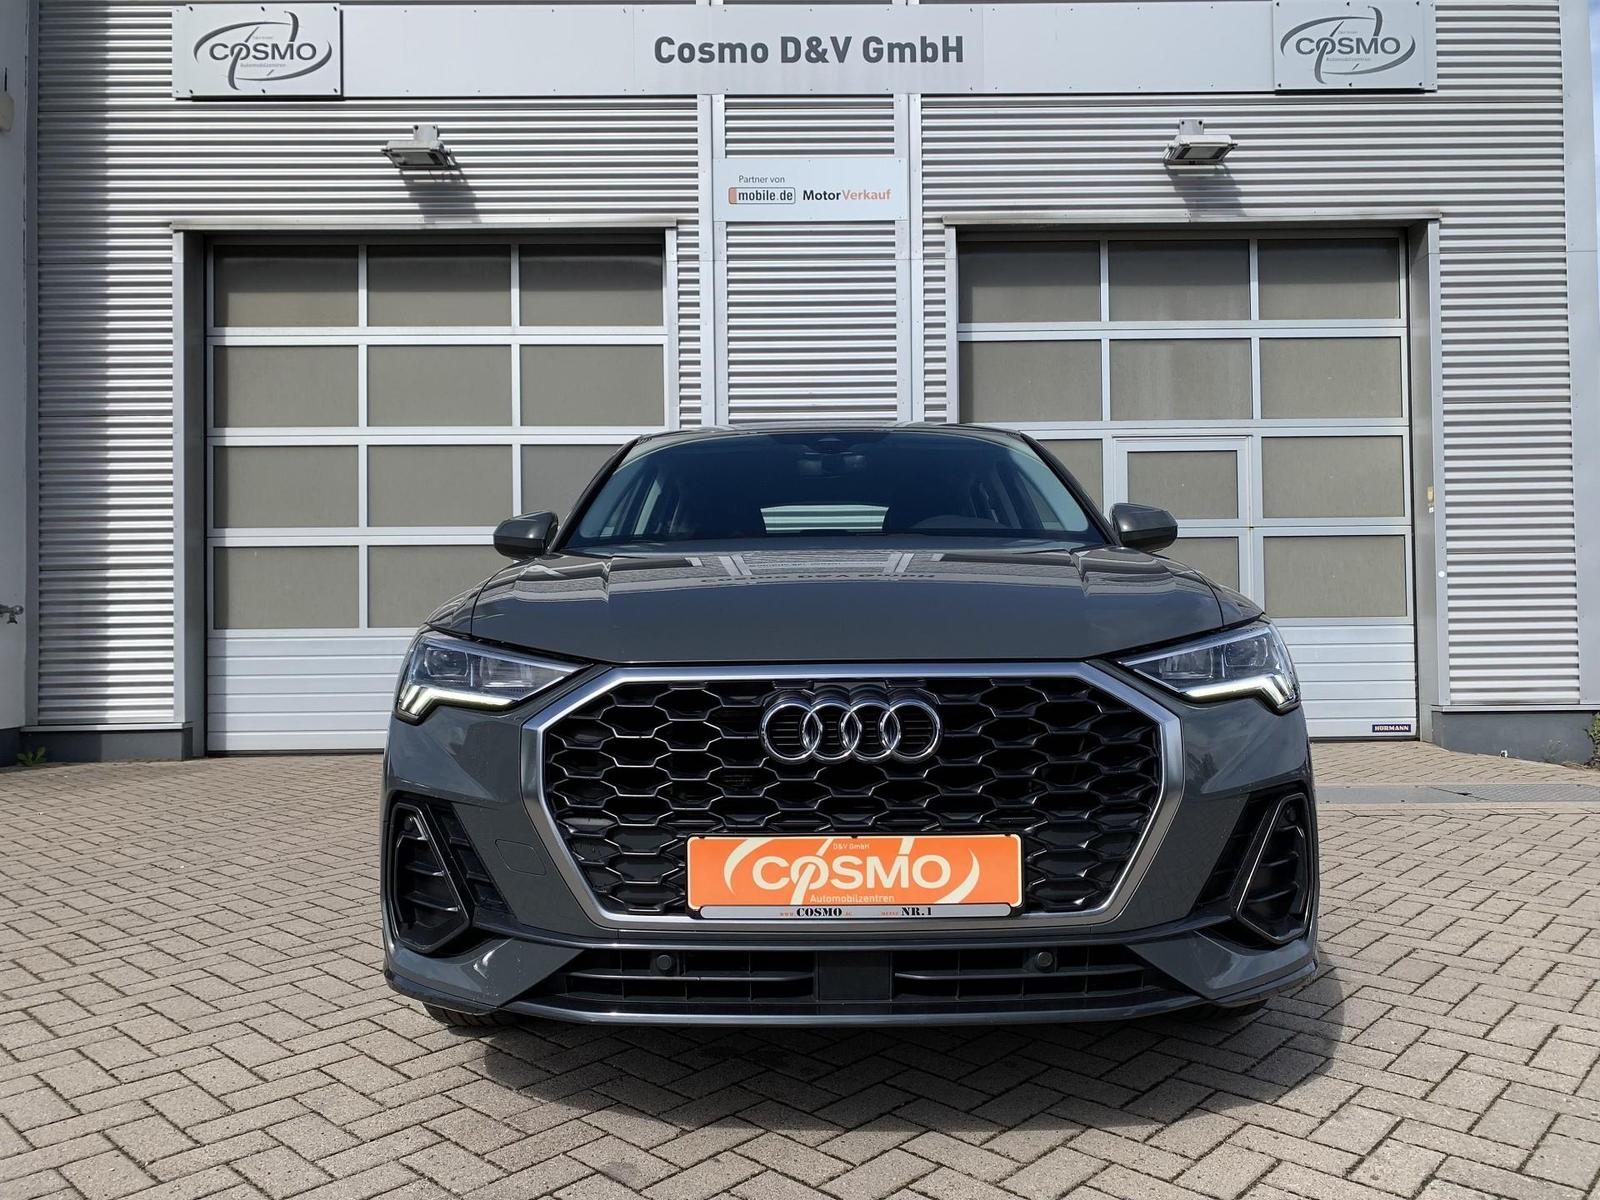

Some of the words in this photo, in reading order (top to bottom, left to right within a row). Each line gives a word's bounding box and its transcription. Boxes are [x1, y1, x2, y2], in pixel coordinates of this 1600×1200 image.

[209, 42, 317, 61] COSMO
[654, 36, 769, 64] Cosmo
[779, 35, 852, 64] D&V
[861, 35, 964, 64] GmbH
[1295, 36, 1401, 55] COSMO
[738, 175, 768, 184] Partner
[738, 189, 793, 201] mobile.de
[849, 842, 870, 850] GmbH
[752, 854, 951, 890] COSMO
[809, 893, 895, 903] Automobilzentren
